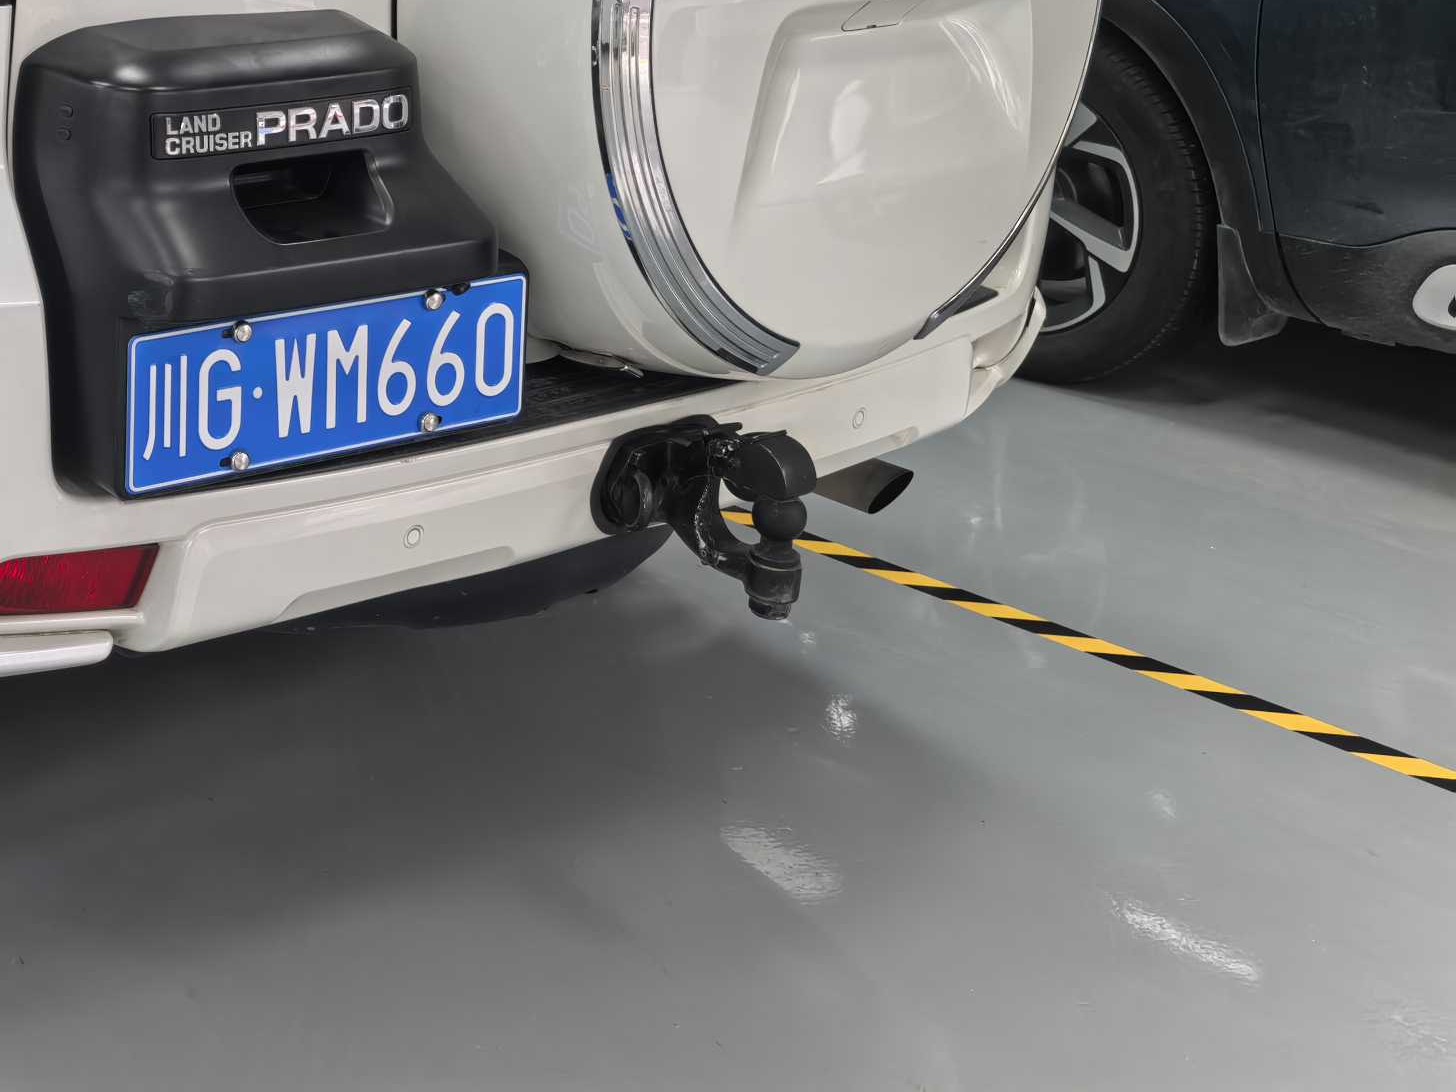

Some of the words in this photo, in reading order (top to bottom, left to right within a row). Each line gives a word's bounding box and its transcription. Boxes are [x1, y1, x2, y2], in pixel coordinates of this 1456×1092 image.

[164, 112, 222, 136] LAND
[164, 130, 252, 156] CRUISER
[256, 94, 409, 147] PRADO
